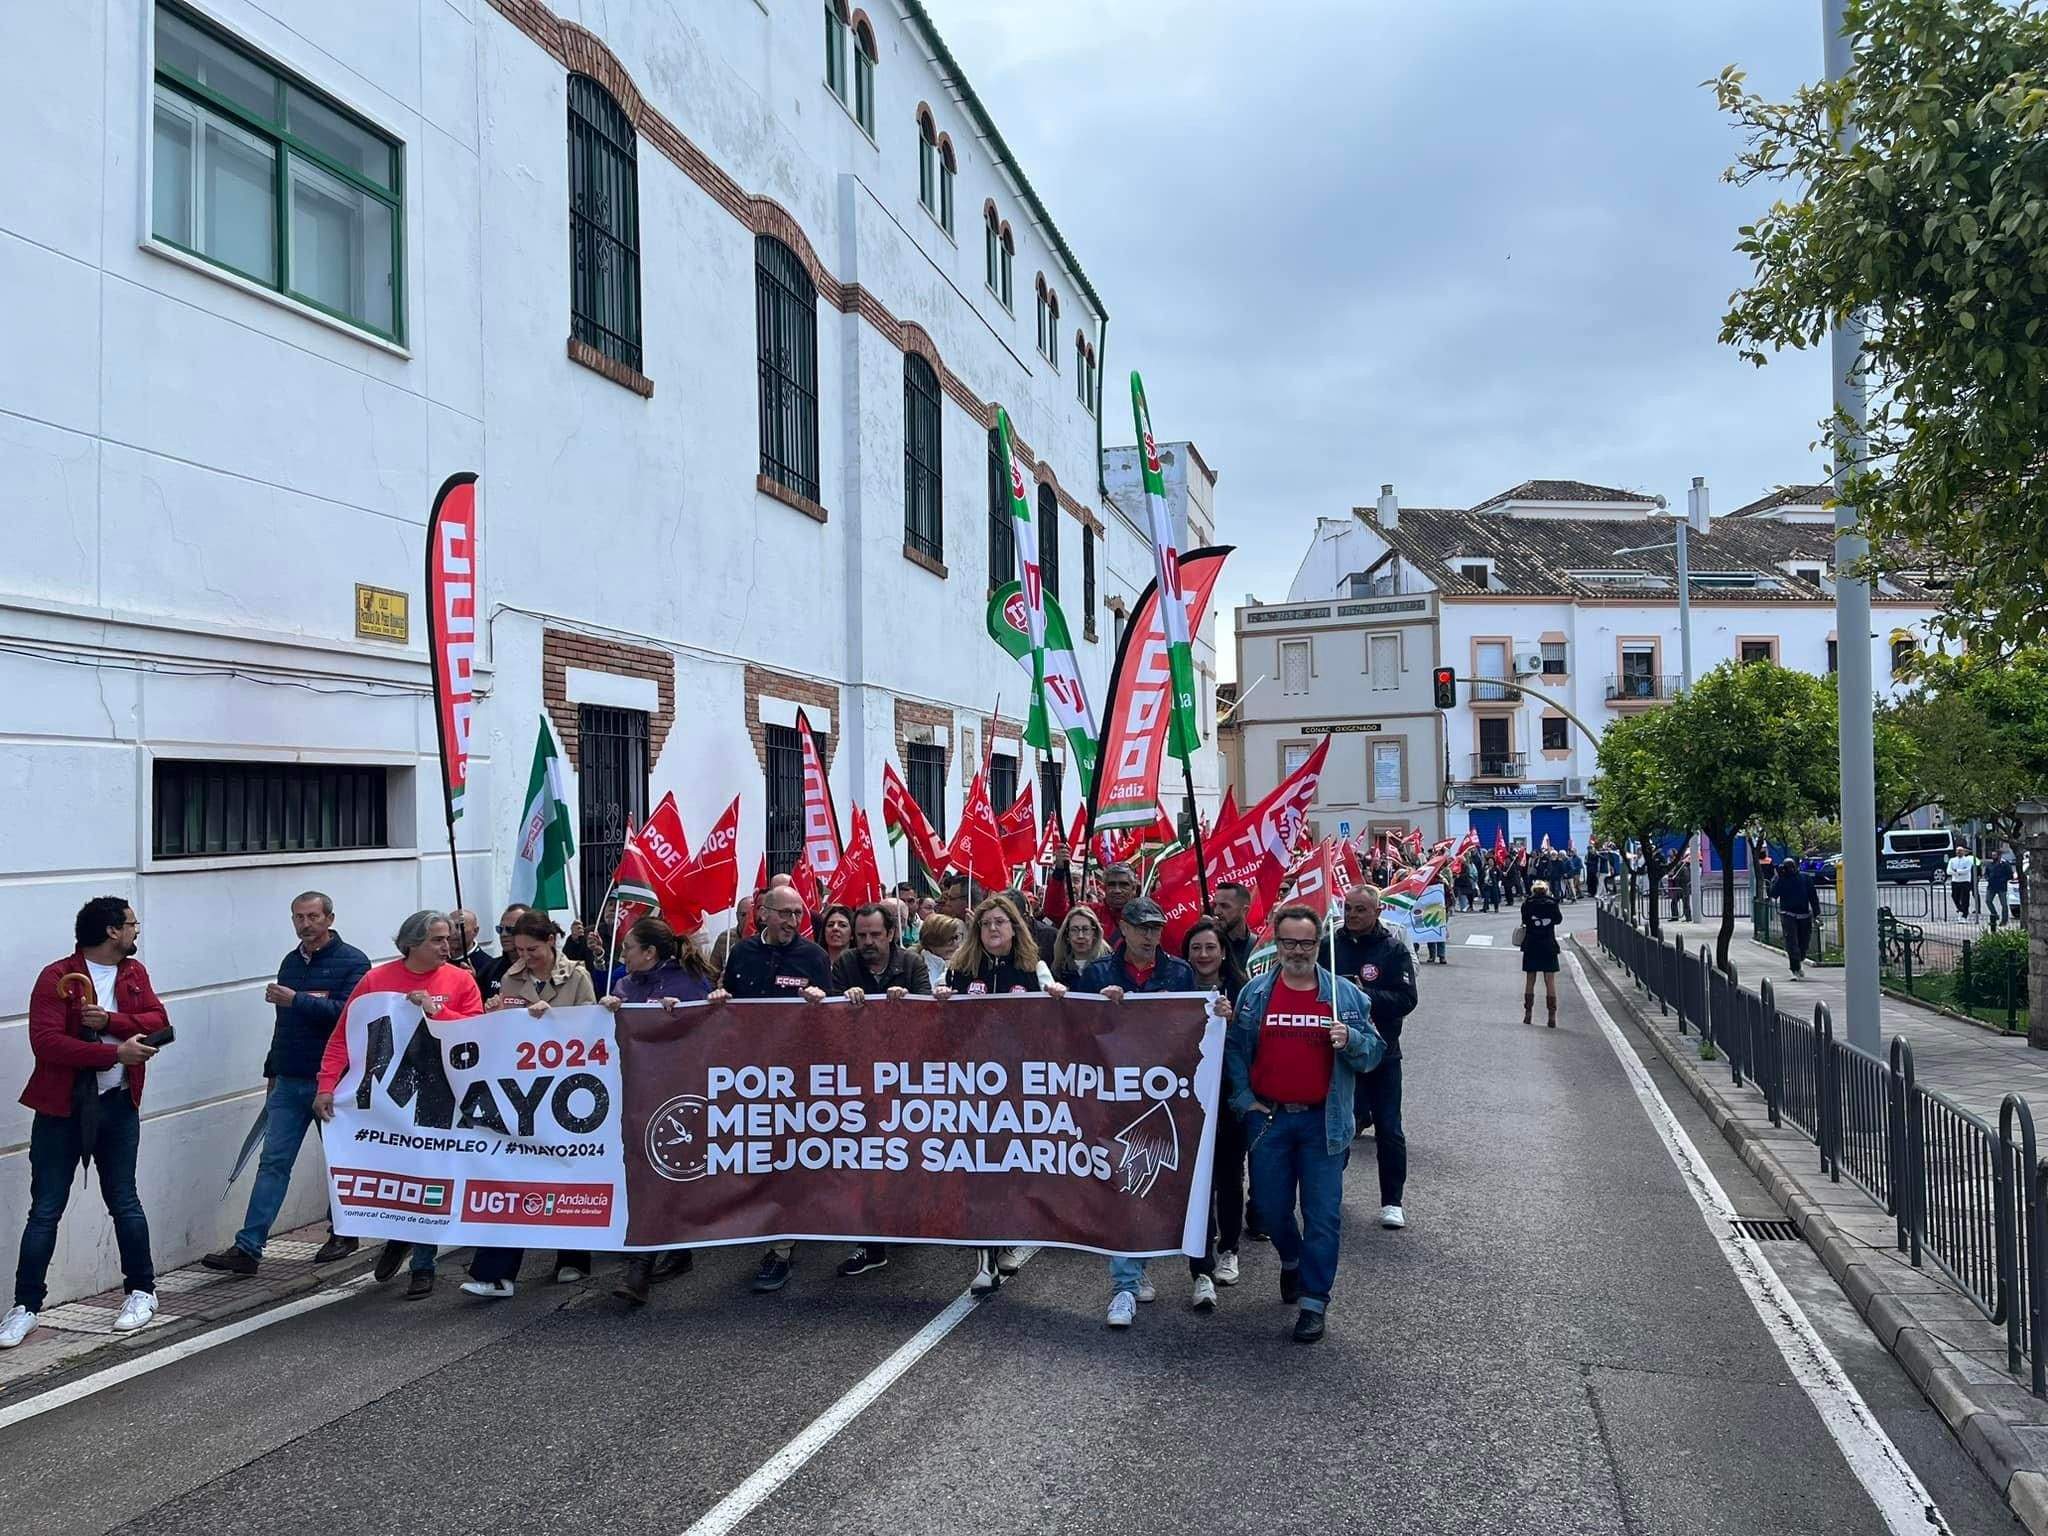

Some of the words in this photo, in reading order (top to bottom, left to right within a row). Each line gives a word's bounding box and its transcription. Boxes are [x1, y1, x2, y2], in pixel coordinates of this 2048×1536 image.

[1110, 783, 1144, 800] Cádiz
[642, 824, 682, 869] PSOE
[1265, 1014, 1320, 1027] CCOO
[516, 1039, 609, 1071] 2024
[707, 1066, 796, 1099] POR
[809, 1063, 863, 1097] EL
[873, 1061, 1008, 1098] PLENO
[1022, 1061, 1190, 1102] EMPLEO:
[707, 1100, 867, 1137] MENOS
[878, 1099, 1083, 1140] JORNADA,
[354, 1128, 488, 1153] #PLENOEMPLEO
[505, 1141, 605, 1157] #1MAYO2024
[706, 1137, 909, 1176] MEJORES
[921, 1138, 1112, 1181] SALARIOS
[333, 1174, 423, 1204] CCOO
[470, 1191, 520, 1214] UGT
[557, 1193, 609, 1206] Andalucía
[380, 1211, 406, 1222] Campo
[418, 1217, 450, 1226] Gibraltar
[556, 1207, 574, 1216] Campo
